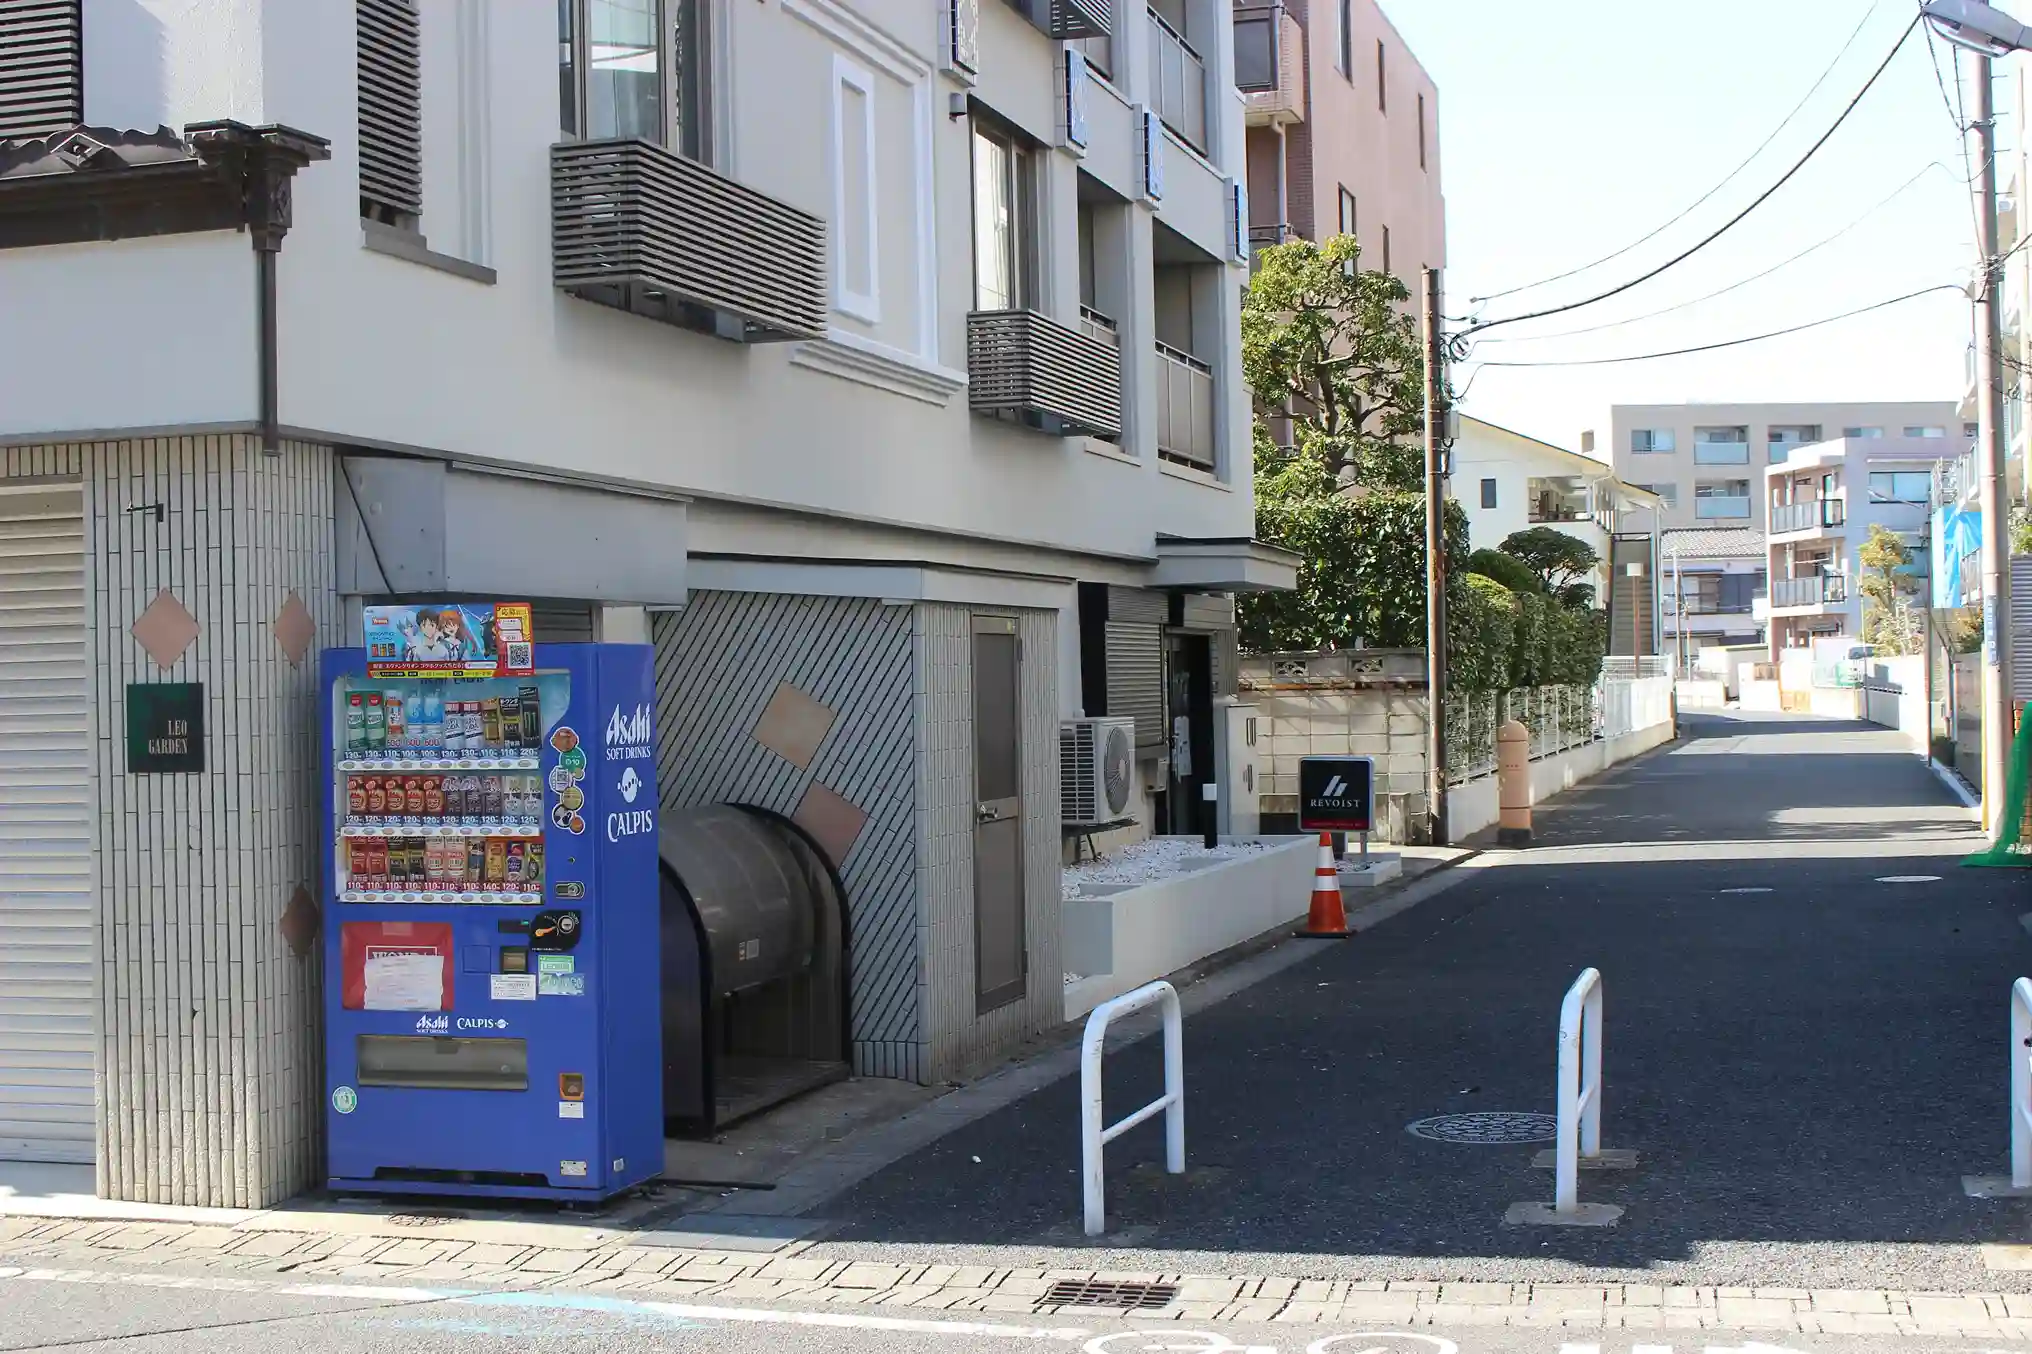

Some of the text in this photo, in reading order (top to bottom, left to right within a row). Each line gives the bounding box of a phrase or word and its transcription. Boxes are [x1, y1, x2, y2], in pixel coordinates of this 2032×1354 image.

[168, 719, 188, 736] LEO
[606, 703, 651, 746] Asahi
[148, 738, 188, 754] GARDEN
[606, 746, 651, 760] SOFT DRINKS
[1310, 799, 1360, 808] REVOIST
[607, 809, 653, 842] CALPIS
[416, 1014, 494, 1030] Asahi CALPIS
